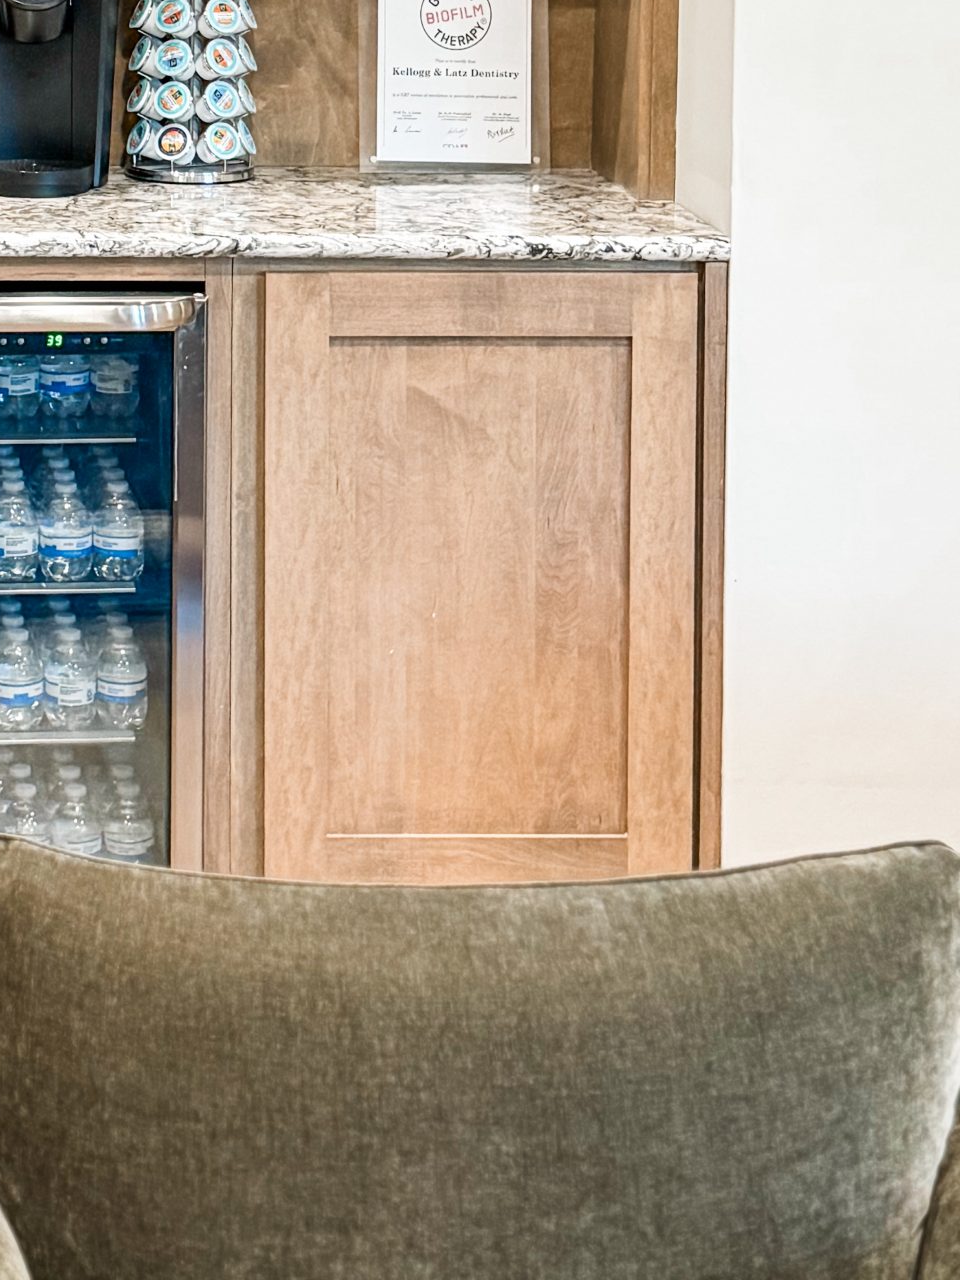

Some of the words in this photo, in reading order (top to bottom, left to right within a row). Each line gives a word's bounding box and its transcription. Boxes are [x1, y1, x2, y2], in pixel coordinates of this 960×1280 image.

[426, 3, 484, 24] BIOFILM
[434, 21, 485, 47] THERAPY
[392, 67, 431, 78] Kellogg
[433, 68, 442, 76] &
[445, 68, 468, 77] Latz
[471, 69, 520, 80] Dentistry
[46, 334, 63, 347] 39
